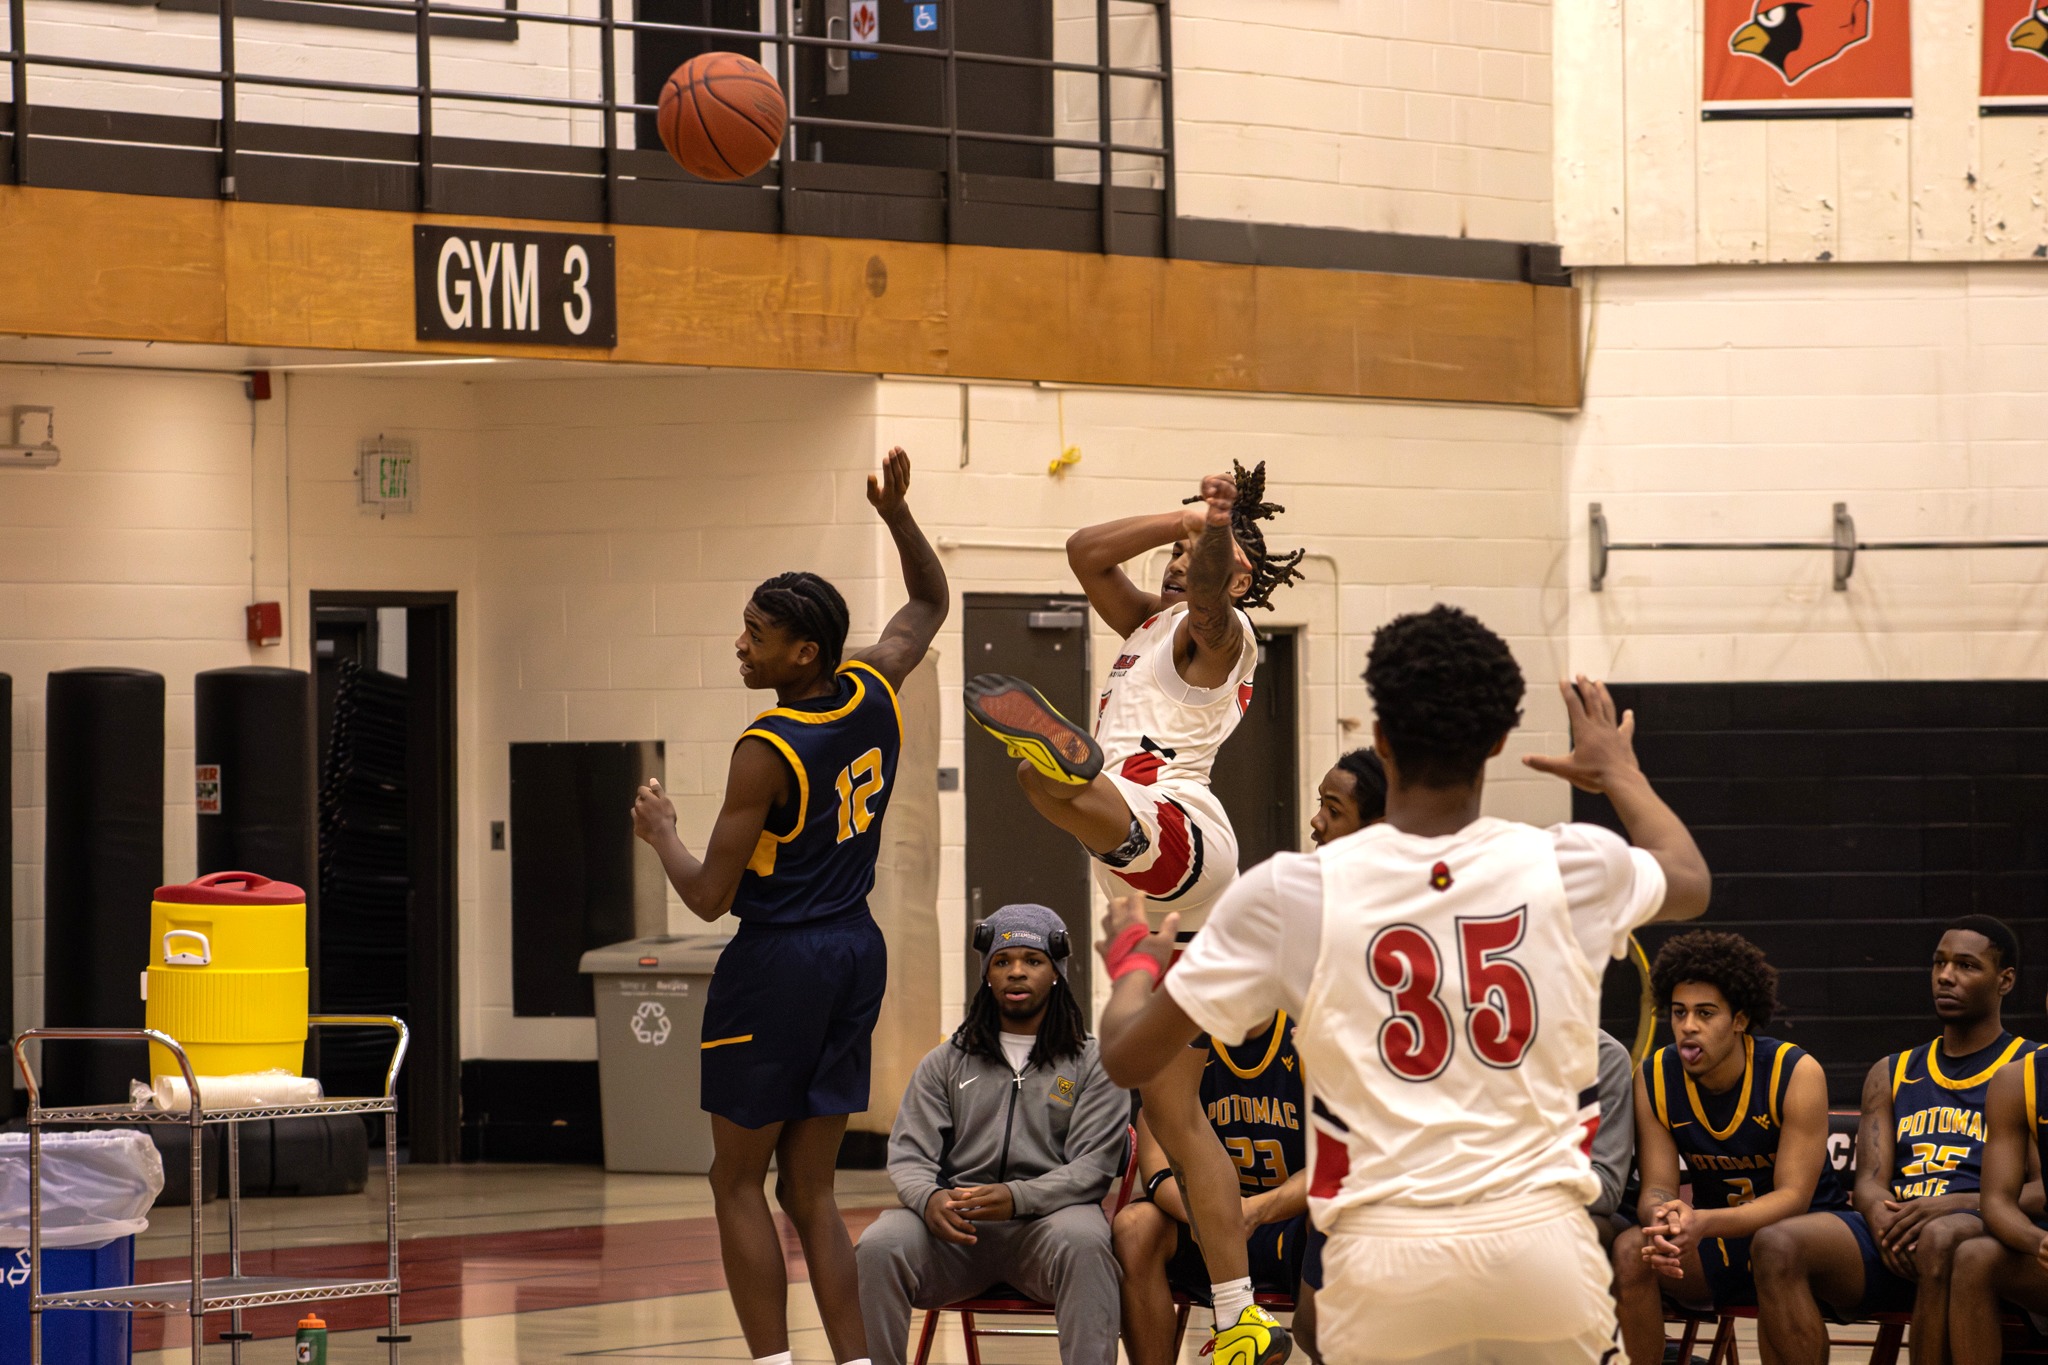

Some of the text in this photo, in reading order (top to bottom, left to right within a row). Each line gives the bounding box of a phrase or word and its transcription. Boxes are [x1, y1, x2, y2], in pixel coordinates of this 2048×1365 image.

[437, 236, 592, 335] GYM 3
[380, 457, 411, 498] EXIT
[835, 747, 885, 845] 12
[1366, 903, 1540, 1083] 35
[1207, 1094, 1300, 1130] POTOMAC
[1896, 1106, 1989, 1144] POTOMA
[1224, 1136, 1290, 1187] 23
